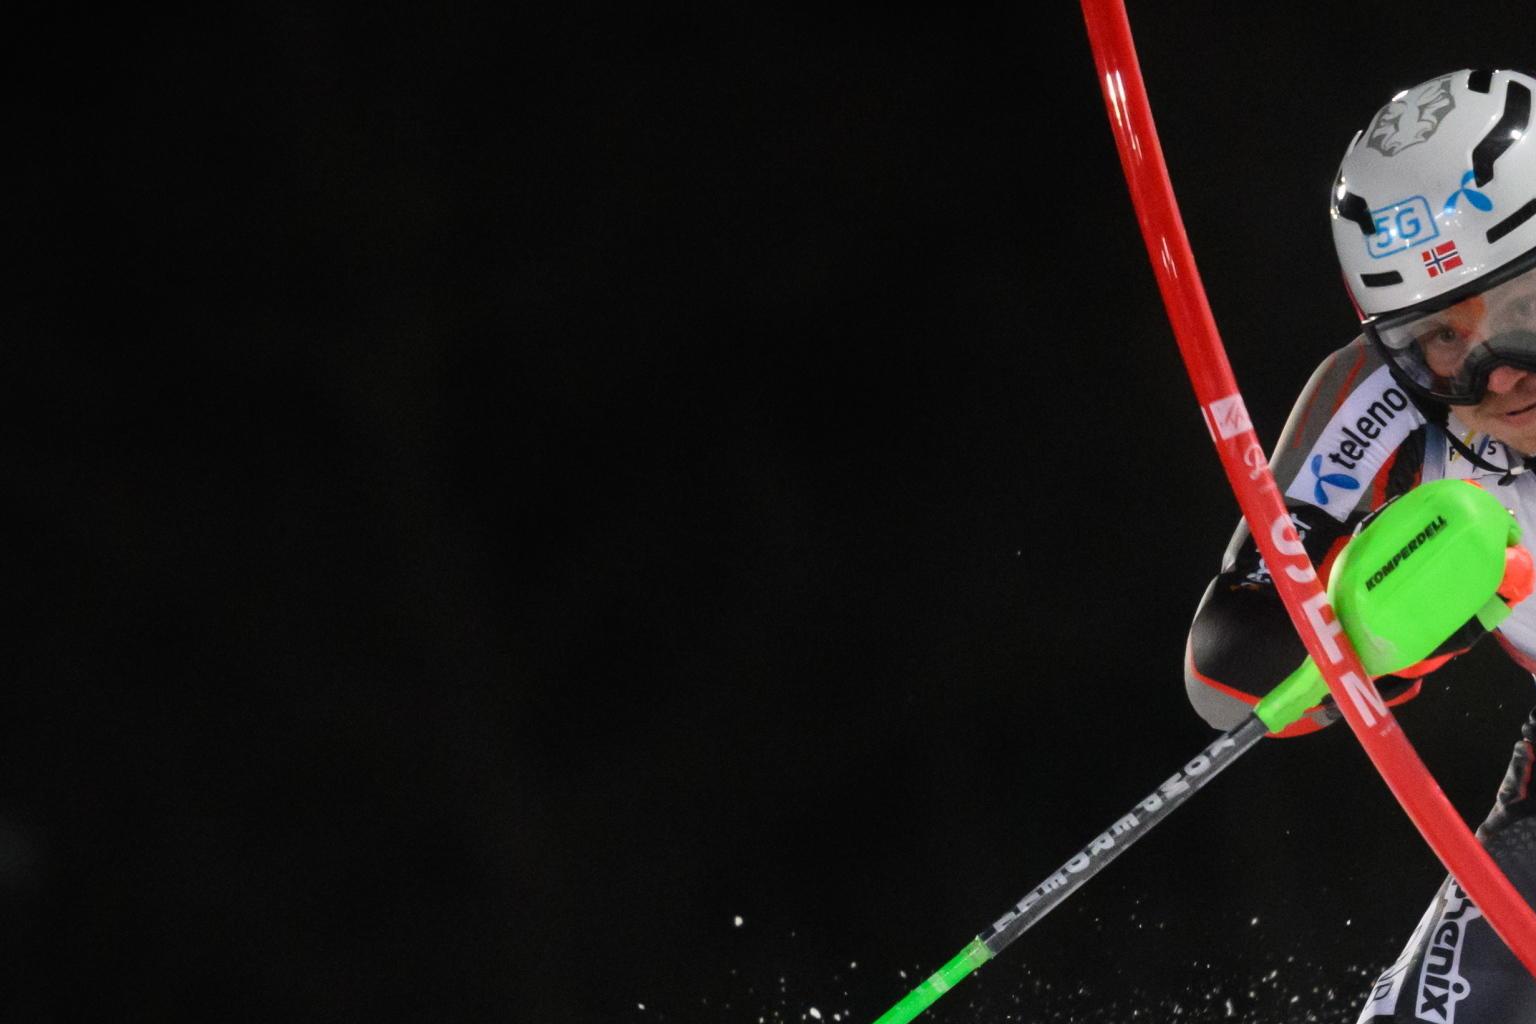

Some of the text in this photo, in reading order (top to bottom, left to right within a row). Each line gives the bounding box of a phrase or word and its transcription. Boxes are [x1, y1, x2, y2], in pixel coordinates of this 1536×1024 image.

[1375, 207, 1422, 250] 5G
[1328, 384, 1409, 470] teleno
[1366, 515, 1448, 592] KOMPERDELL
[1421, 880, 1474, 1021] henix
